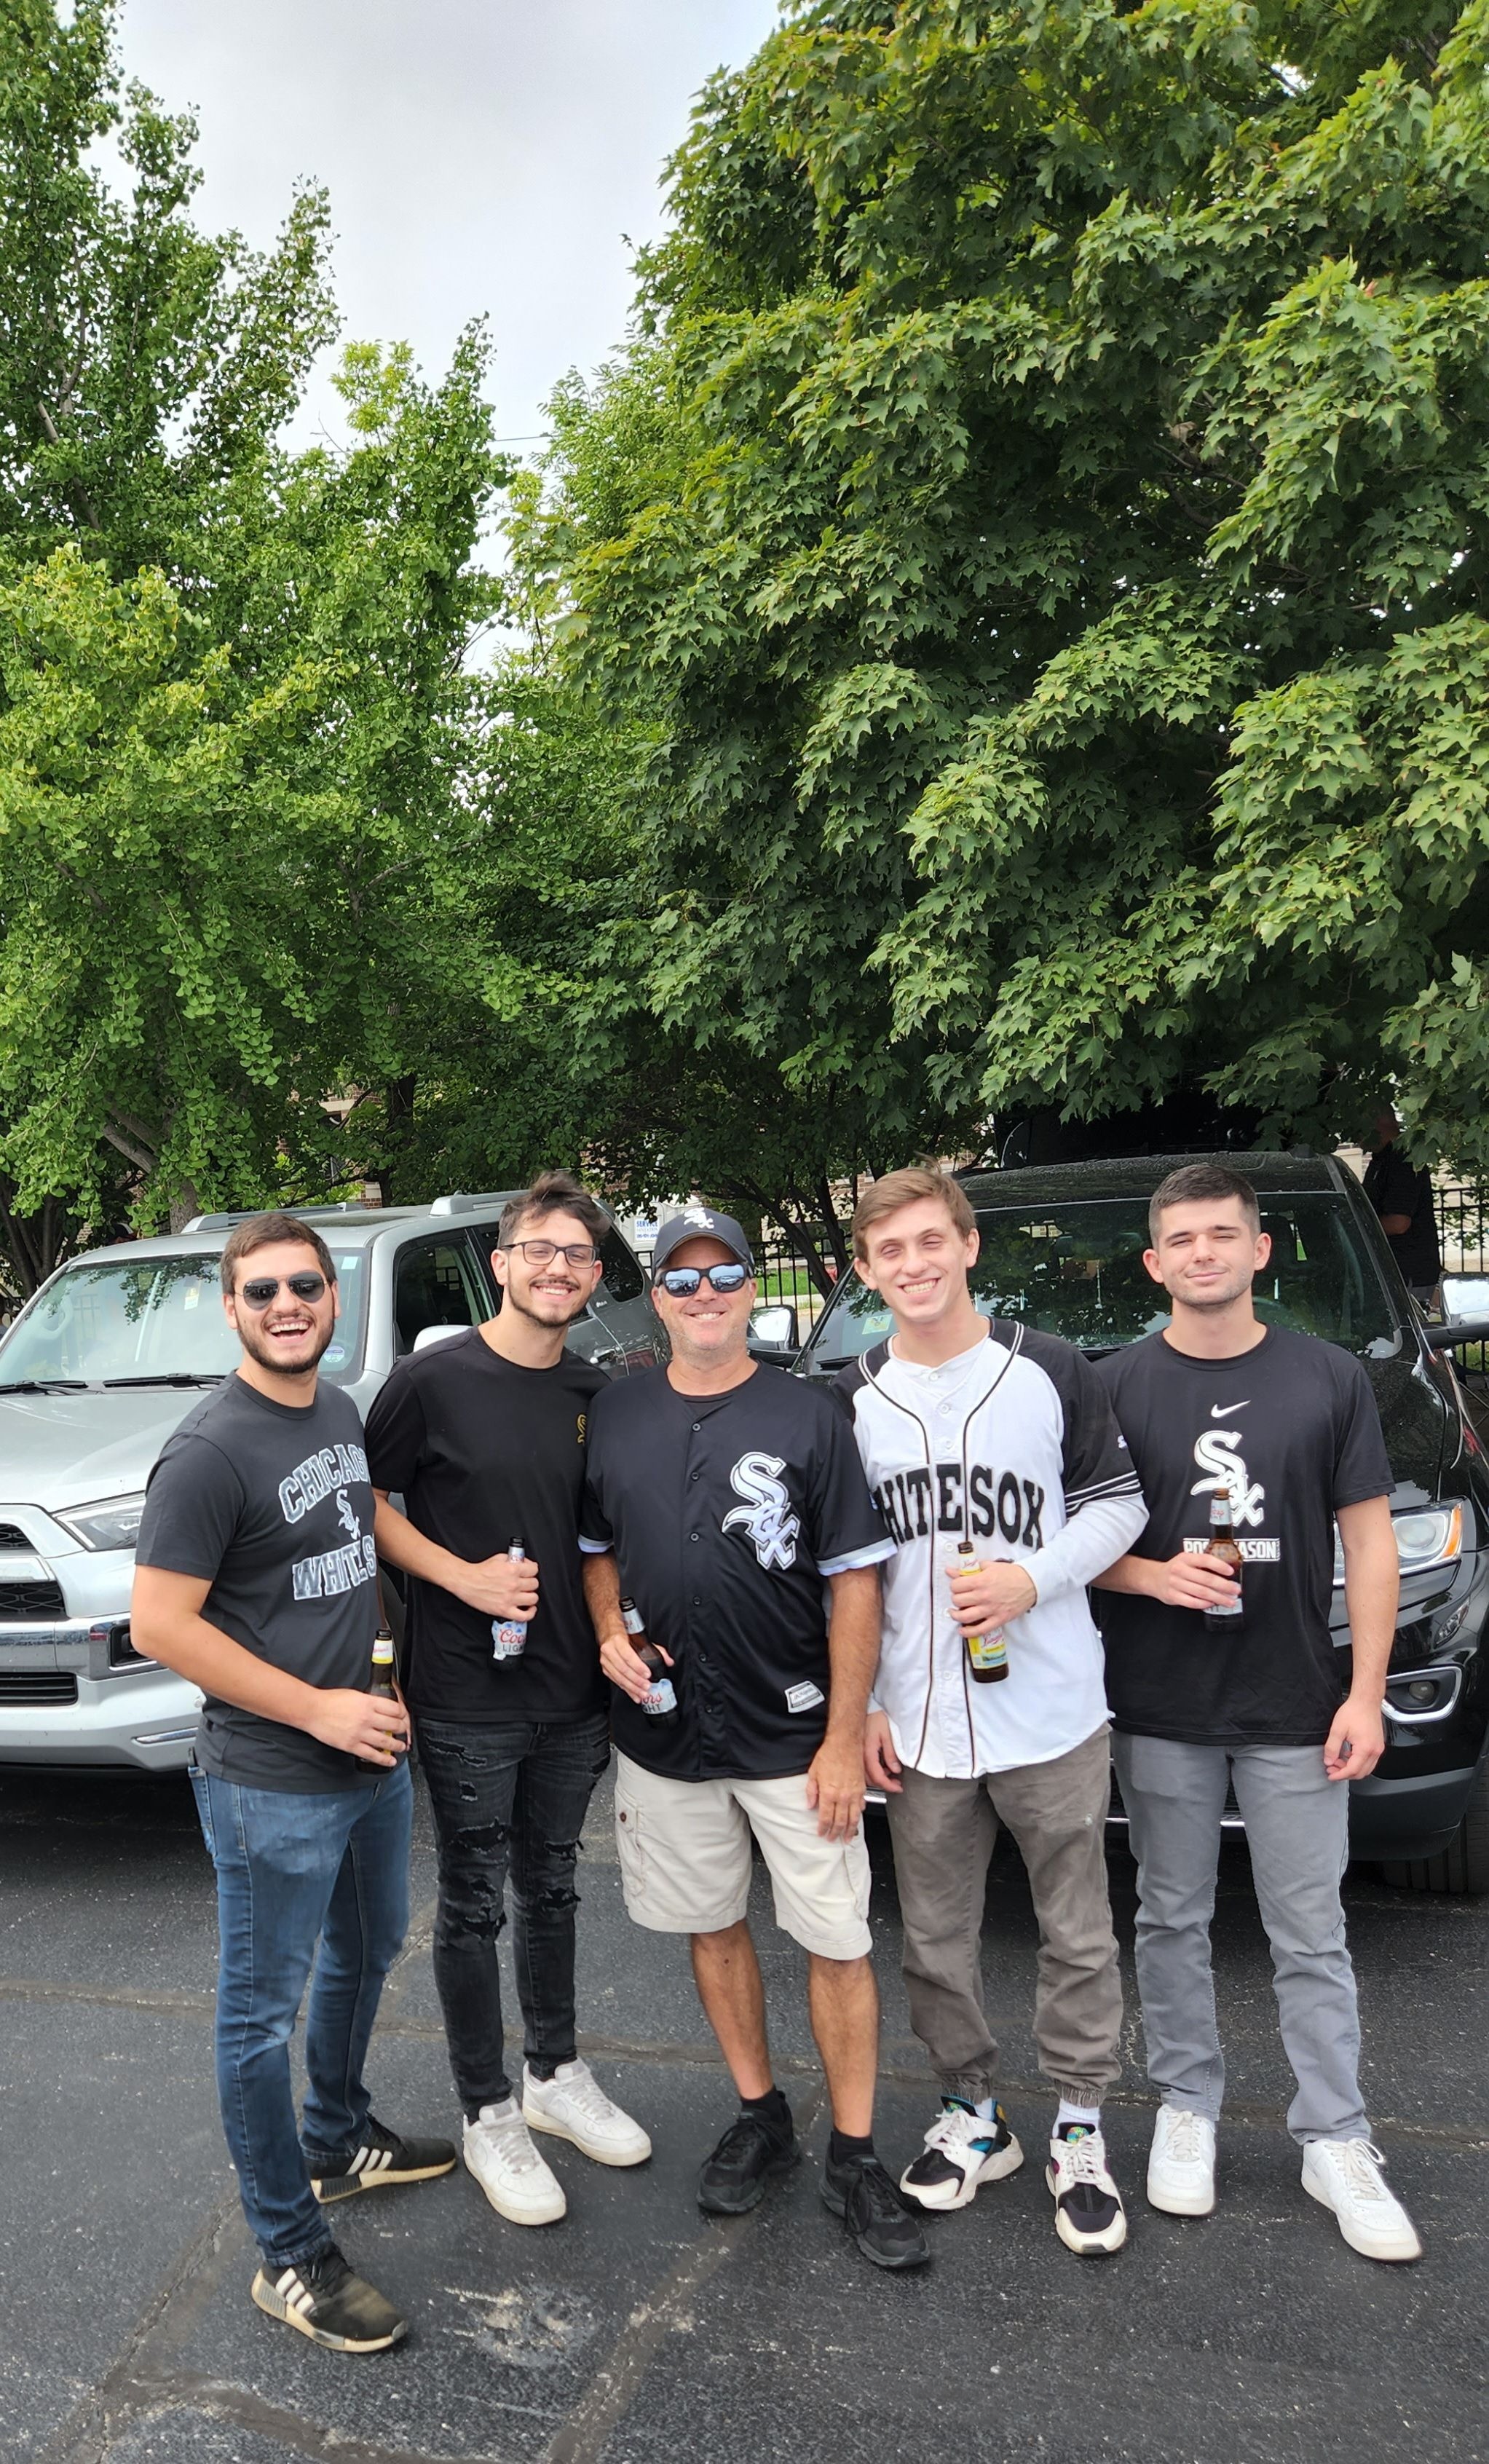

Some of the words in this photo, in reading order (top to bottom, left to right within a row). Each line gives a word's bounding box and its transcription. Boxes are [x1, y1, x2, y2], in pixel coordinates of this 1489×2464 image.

[278, 1444, 371, 1524] CHICAG
[873, 1463, 963, 1547] HITE
[970, 1464, 1045, 1552] SOX
